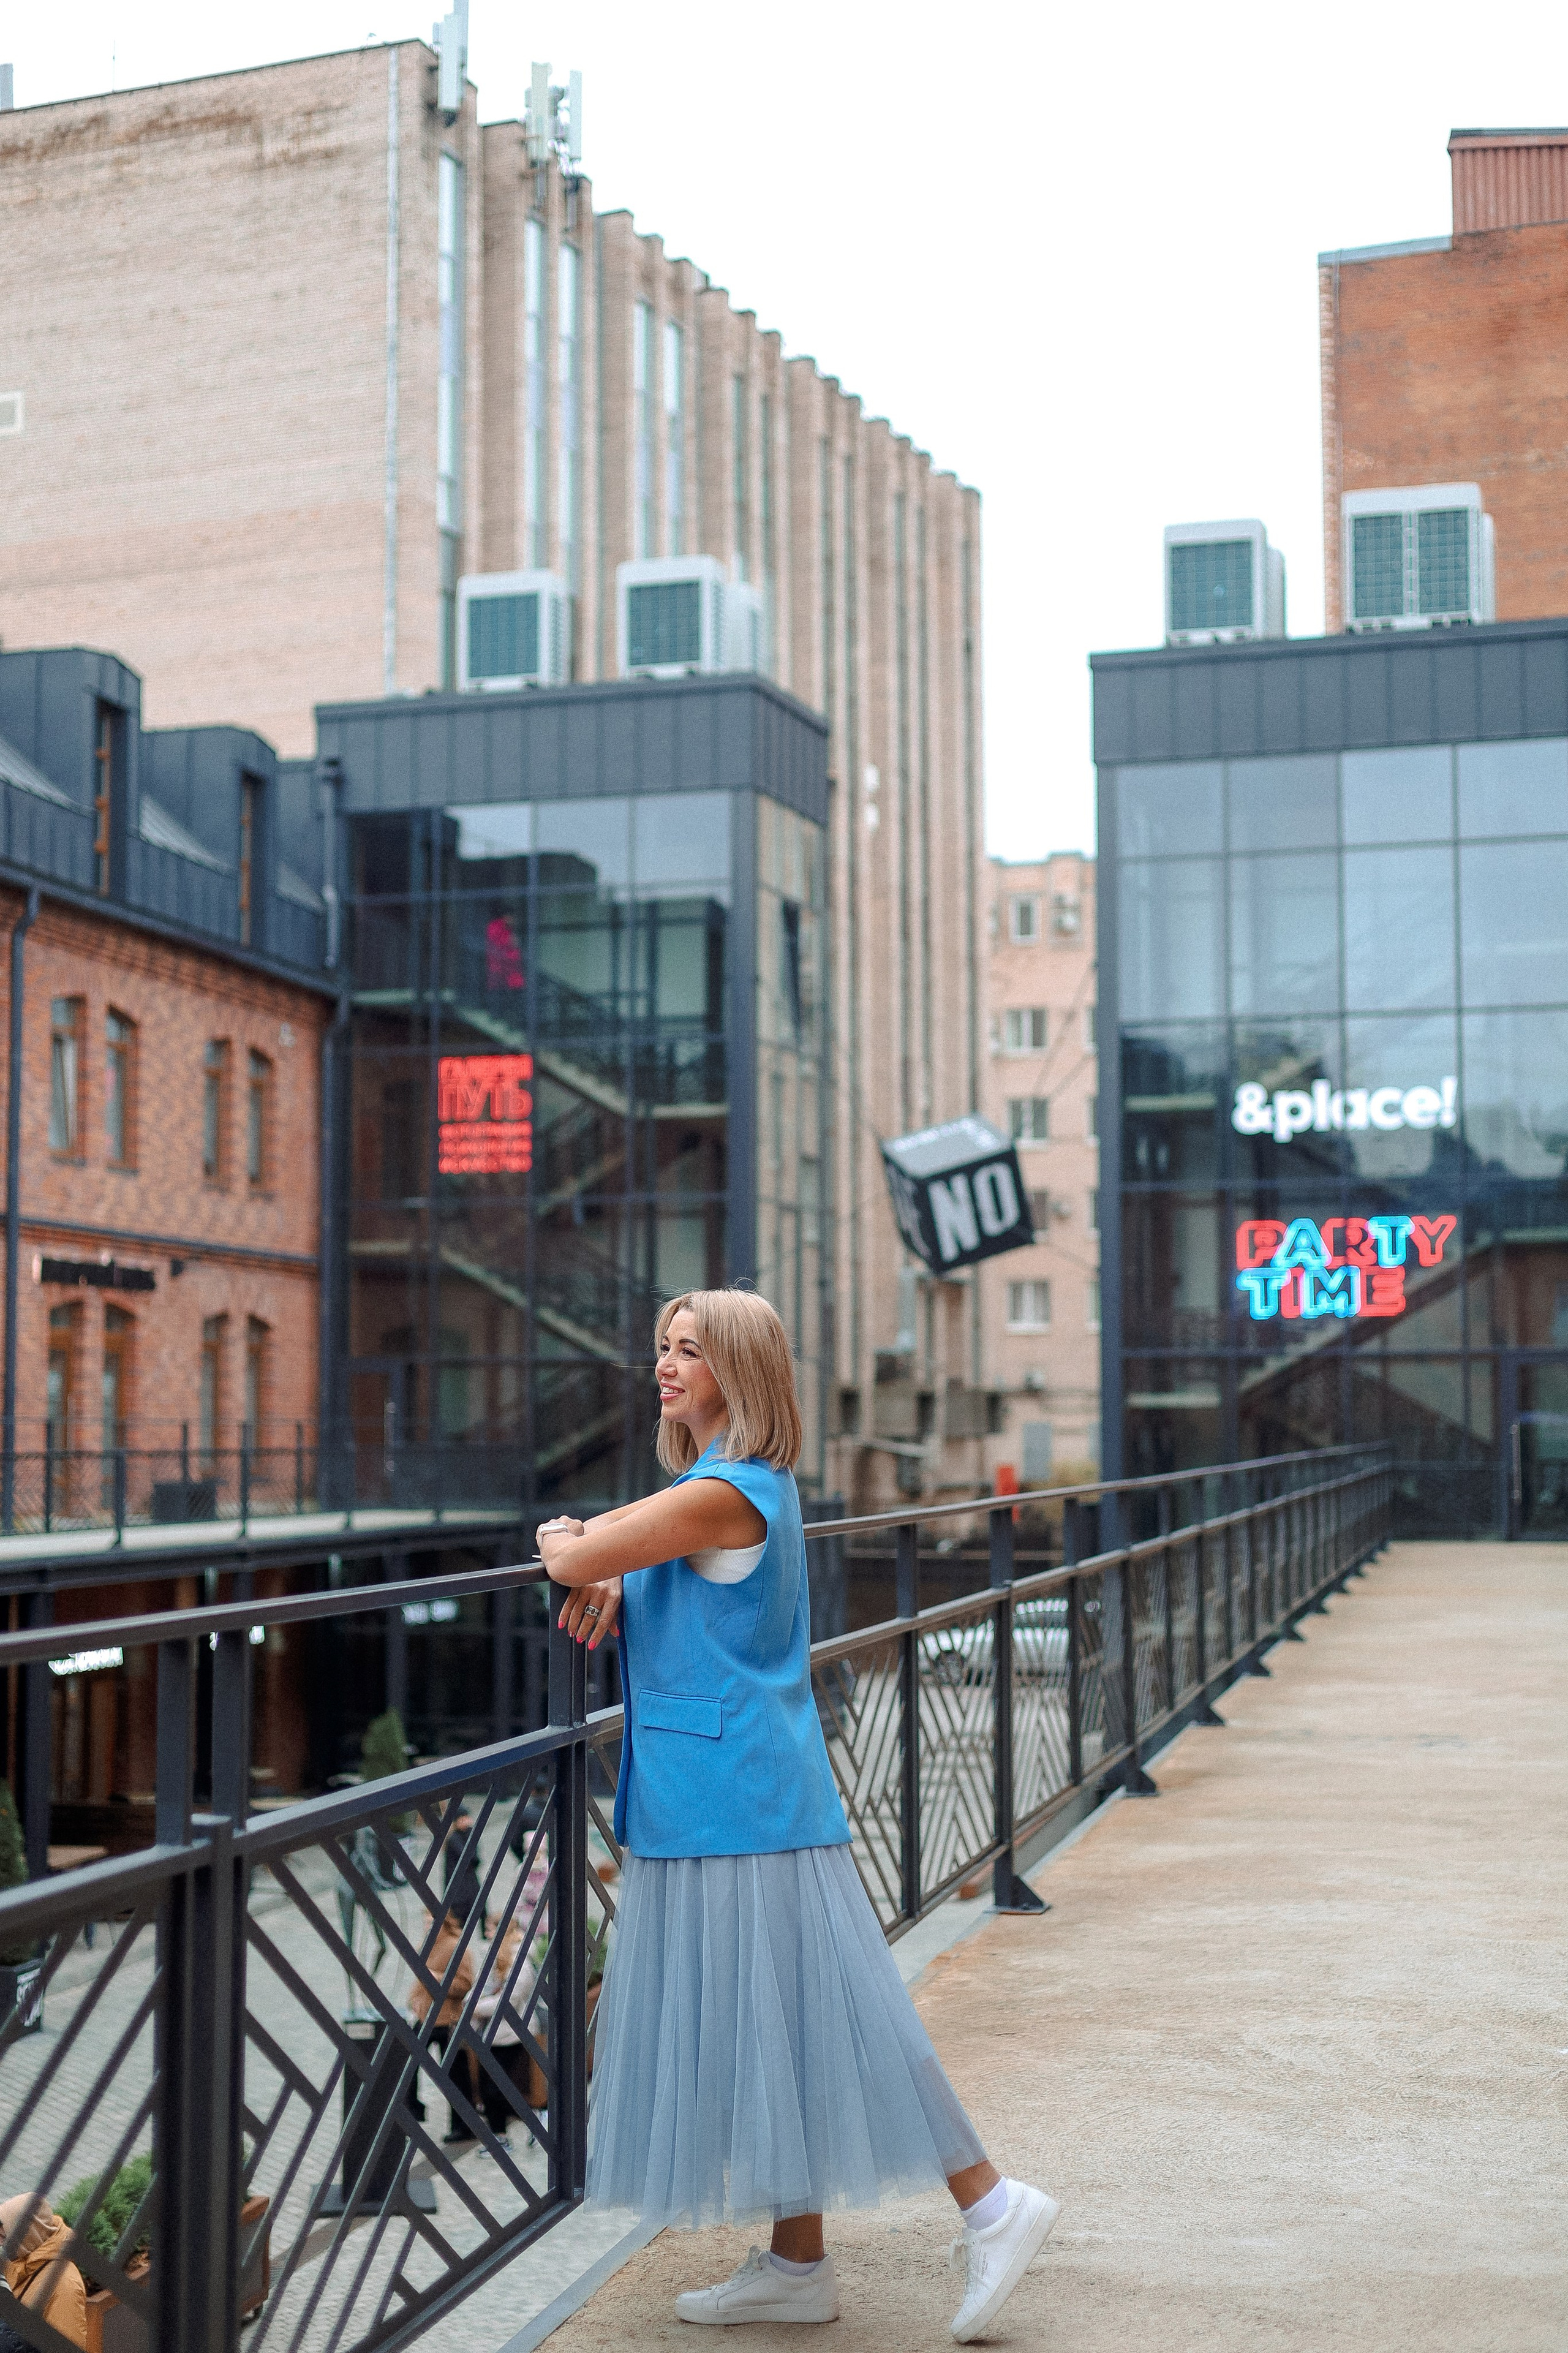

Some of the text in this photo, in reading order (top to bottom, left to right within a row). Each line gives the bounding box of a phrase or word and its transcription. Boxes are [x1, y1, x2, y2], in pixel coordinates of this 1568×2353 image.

[438, 1079, 533, 1122] ПУТЬ
[1232, 1076, 1458, 1143] &place!
[927, 1161, 1021, 1263] NO
[1236, 1214, 1457, 1271] PARTY
[1236, 1265, 1406, 1321] TIME
